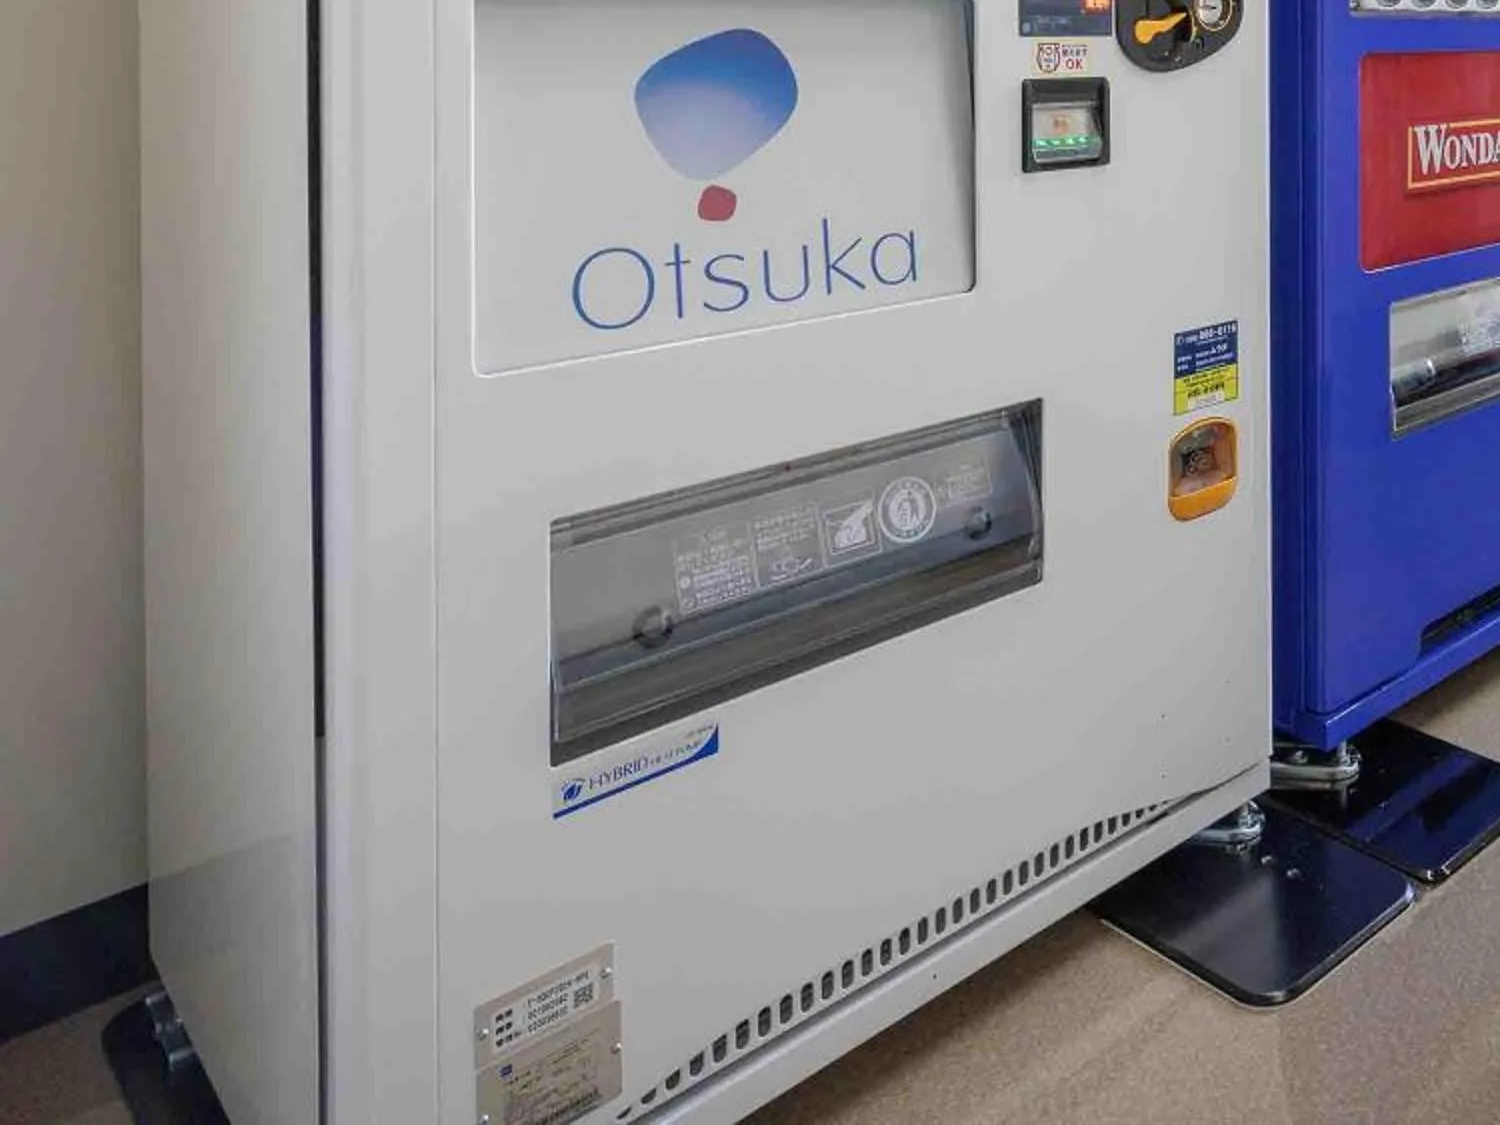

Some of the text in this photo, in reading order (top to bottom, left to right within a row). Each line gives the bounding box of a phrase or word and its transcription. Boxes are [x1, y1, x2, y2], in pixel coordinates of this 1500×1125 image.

[1065, 58, 1084, 71] OK
[572, 217, 918, 331] Otsuka
[588, 756, 650, 791] HYBRID
